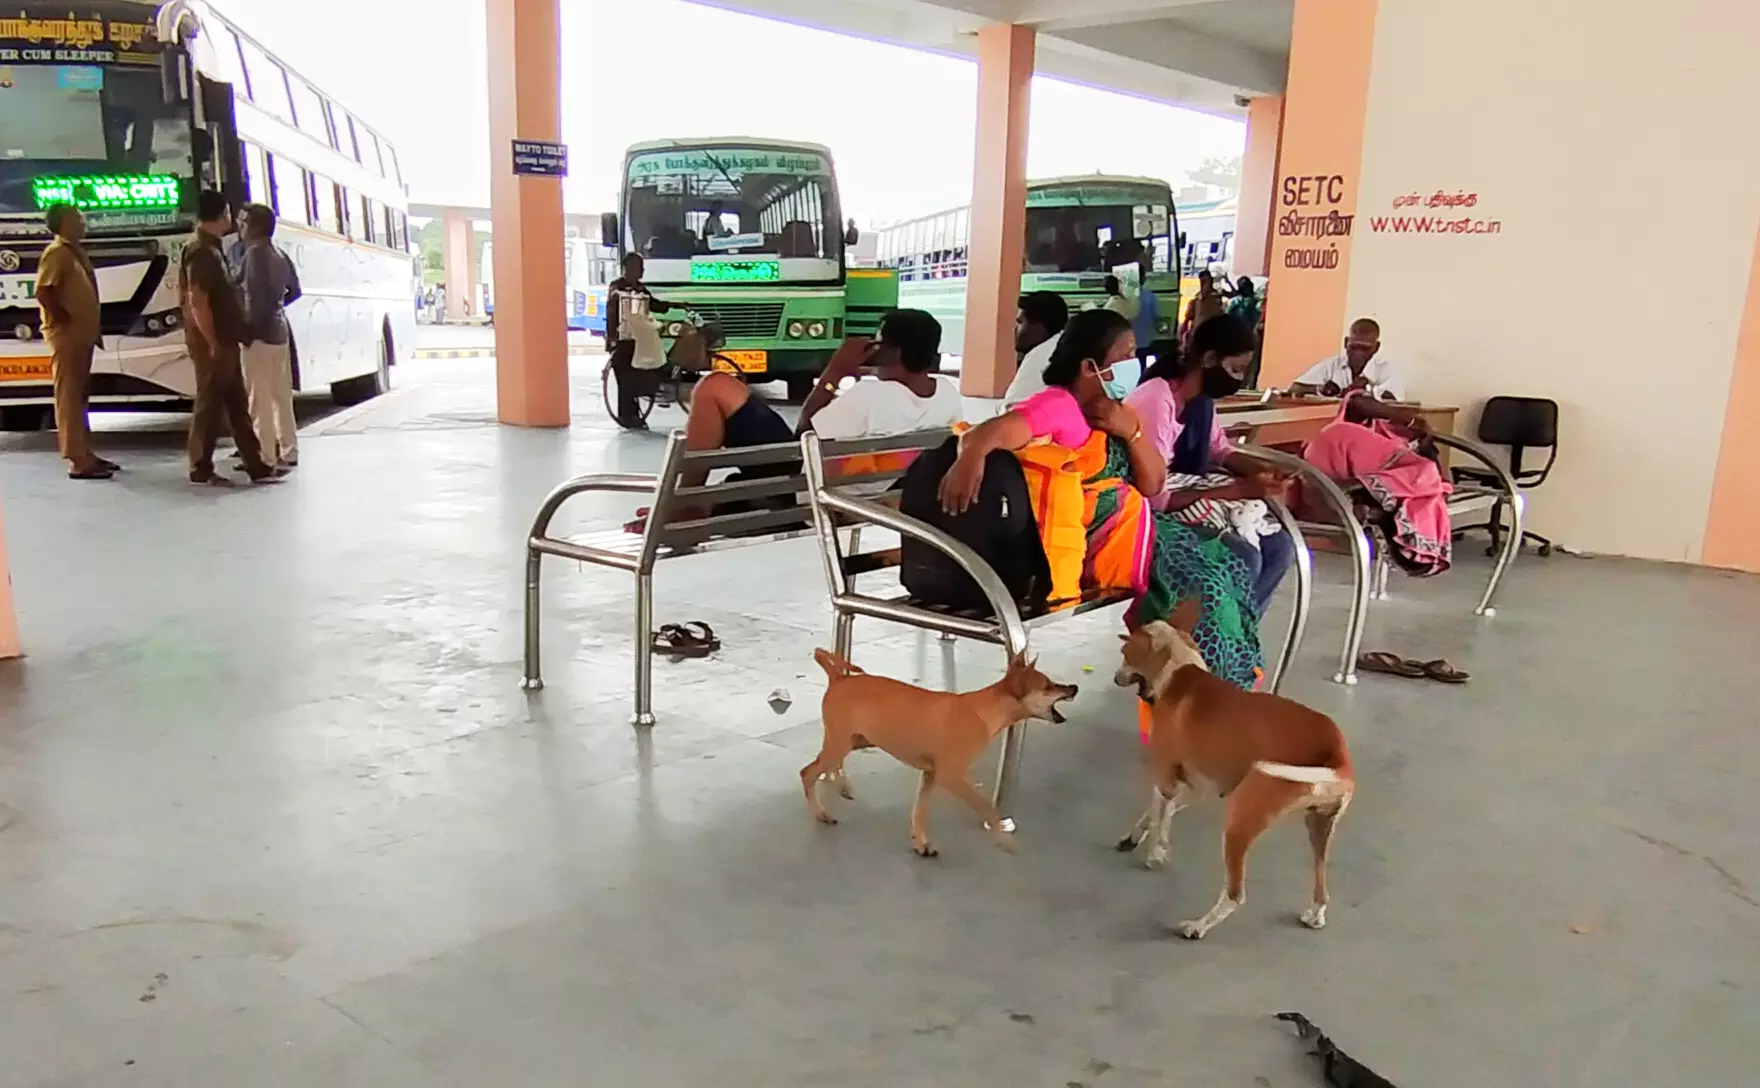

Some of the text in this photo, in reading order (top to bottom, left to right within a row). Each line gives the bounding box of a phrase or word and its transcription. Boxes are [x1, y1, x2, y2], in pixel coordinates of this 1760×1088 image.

[22, 49, 52, 61] CUM
[55, 49, 115, 62] SLEEPER
[1282, 174, 1345, 207] SETC
[1284, 241, 1340, 270] மையம்
